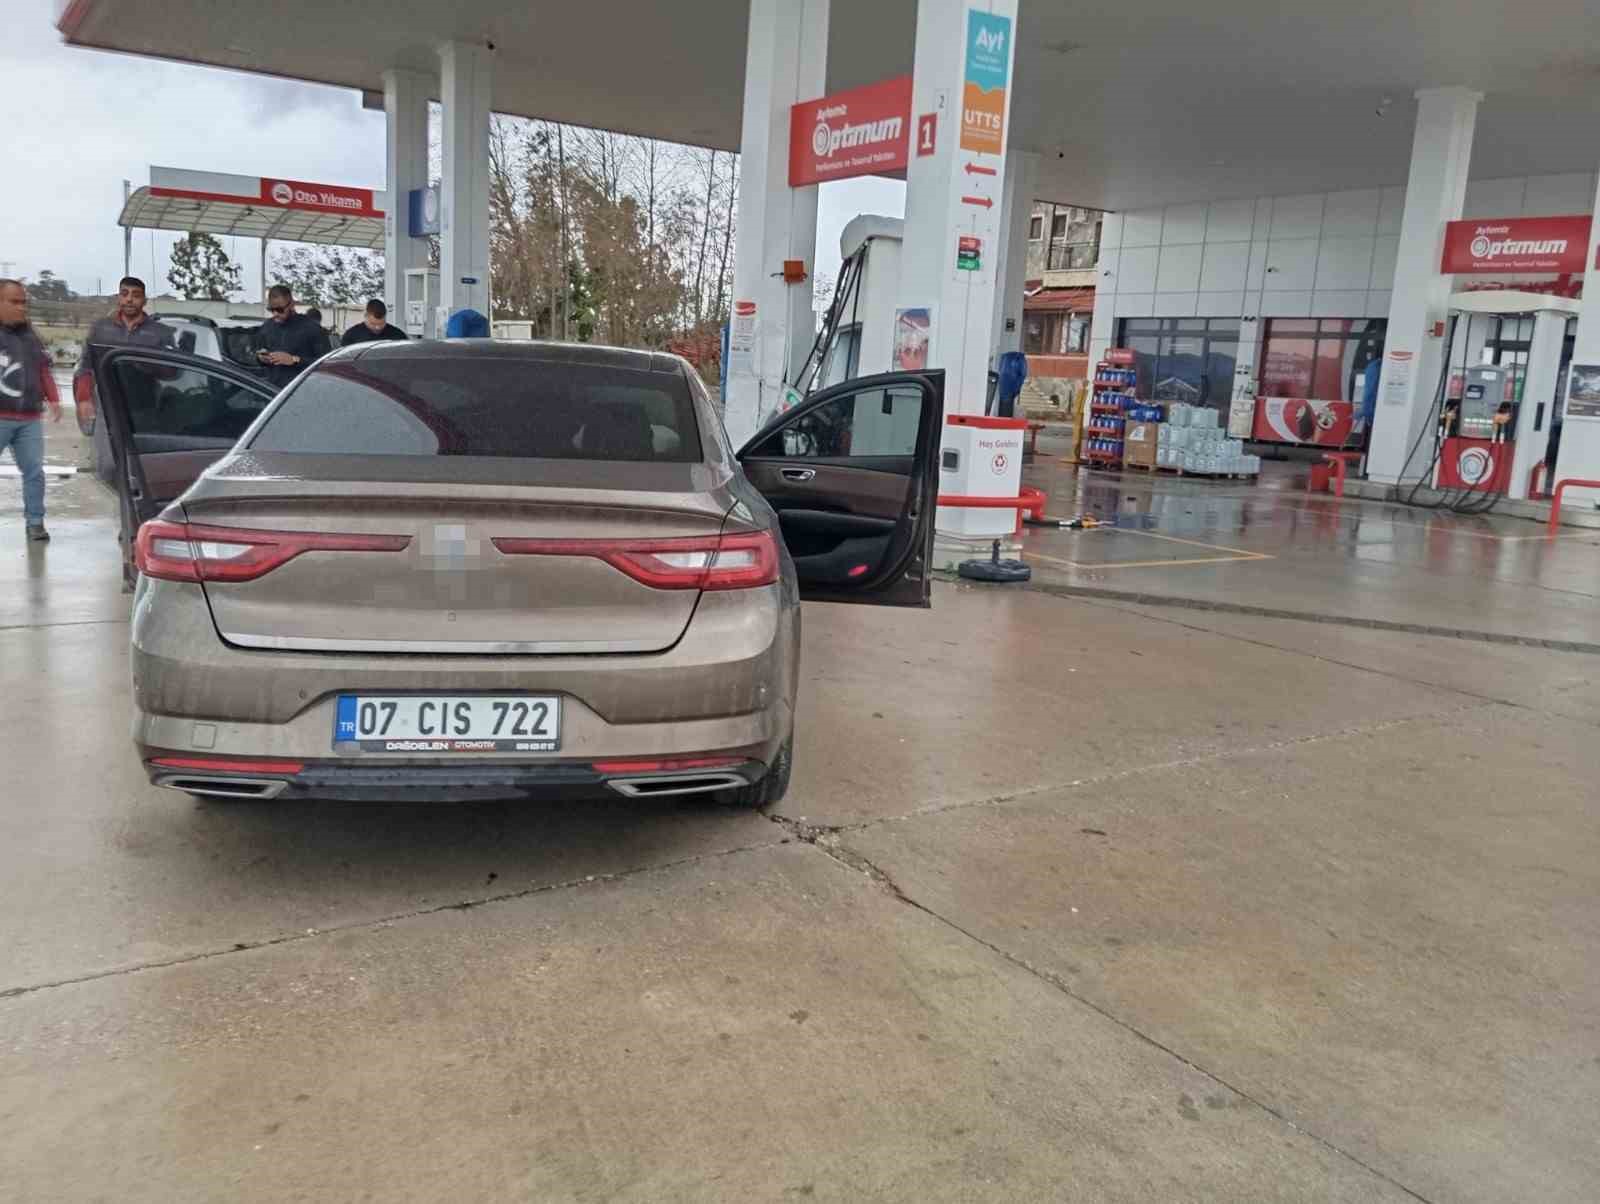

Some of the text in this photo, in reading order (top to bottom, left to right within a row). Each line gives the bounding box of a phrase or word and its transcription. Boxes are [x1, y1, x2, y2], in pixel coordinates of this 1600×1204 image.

[964, 108, 1001, 130] UTTS
[812, 116, 903, 158] Optimum
[921, 120, 933, 149] 1
[295, 190, 318, 202] Oto
[1470, 236, 1568, 259] Optimum
[340, 721, 355, 732] TR
[360, 702, 549, 735] 07 CIS 722
